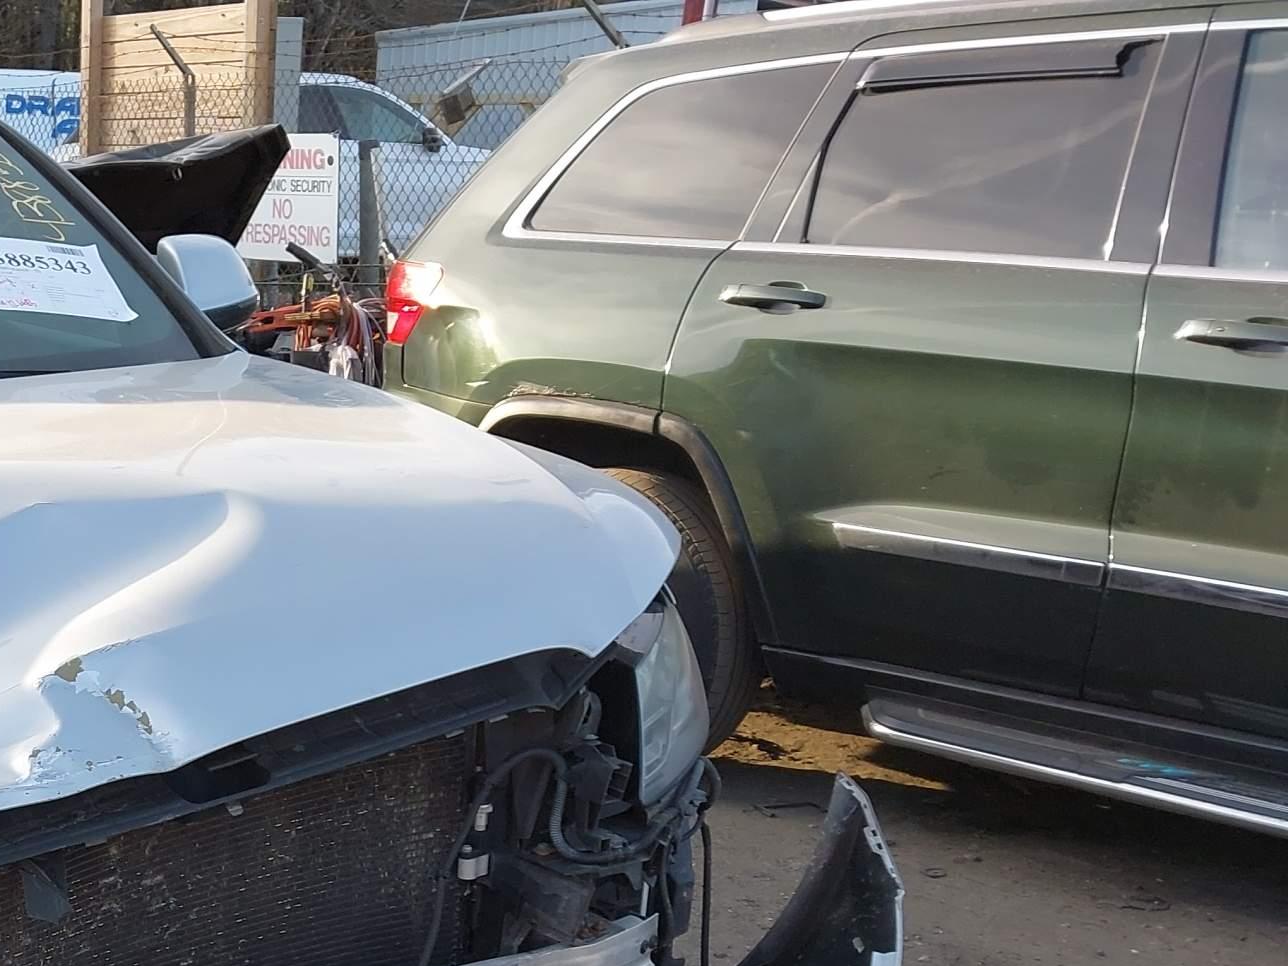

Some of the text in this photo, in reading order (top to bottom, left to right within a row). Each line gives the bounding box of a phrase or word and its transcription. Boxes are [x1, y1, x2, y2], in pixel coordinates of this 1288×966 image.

[278, 148, 325, 170] NING
[290, 179, 333, 193] SECURITY
[272, 198, 293, 219] NO
[242, 223, 331, 247] RESPASSING
